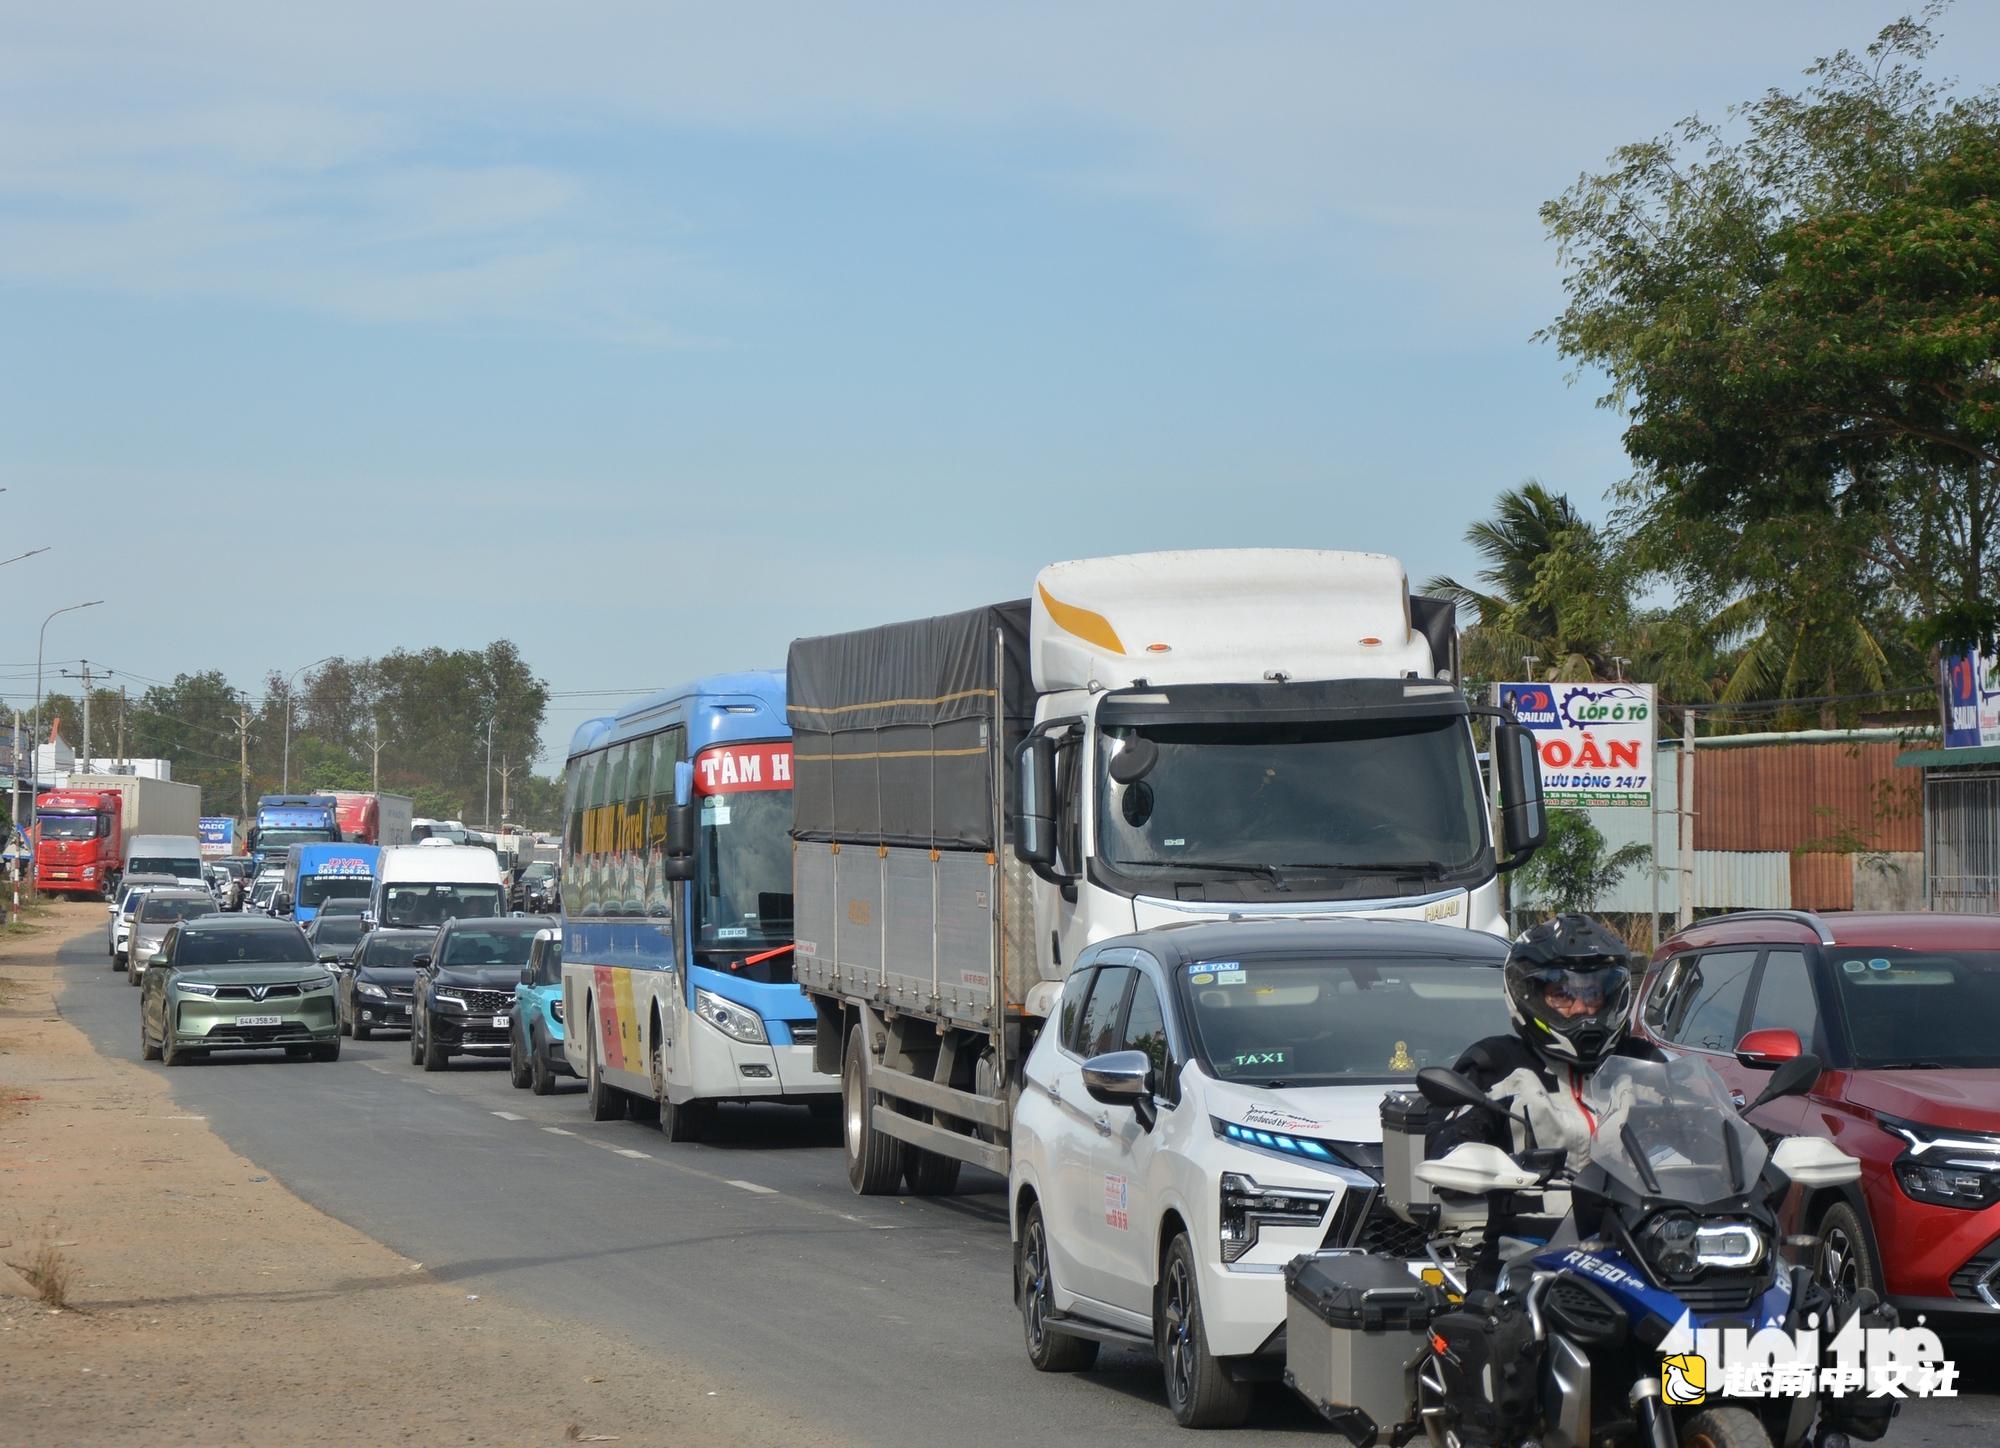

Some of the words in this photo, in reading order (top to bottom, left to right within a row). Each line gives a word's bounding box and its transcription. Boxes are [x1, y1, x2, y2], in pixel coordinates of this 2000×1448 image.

[1517, 711, 1555, 723] SAILUN
[1578, 700, 1608, 720] LỐP
[1612, 703, 1625, 720] Ô
[1628, 703, 1649, 720] TÔ
[1536, 732, 1642, 769] OÀN
[701, 752, 762, 786] TÂM
[1544, 773, 1569, 788] LƯU
[1614, 776, 1647, 788] 24/7
[1193, 965, 1205, 973] XE
[1211, 962, 1236, 971] TAXI
[1235, 1052, 1284, 1066] TAXI
[1563, 1250, 1627, 1283] R1250
